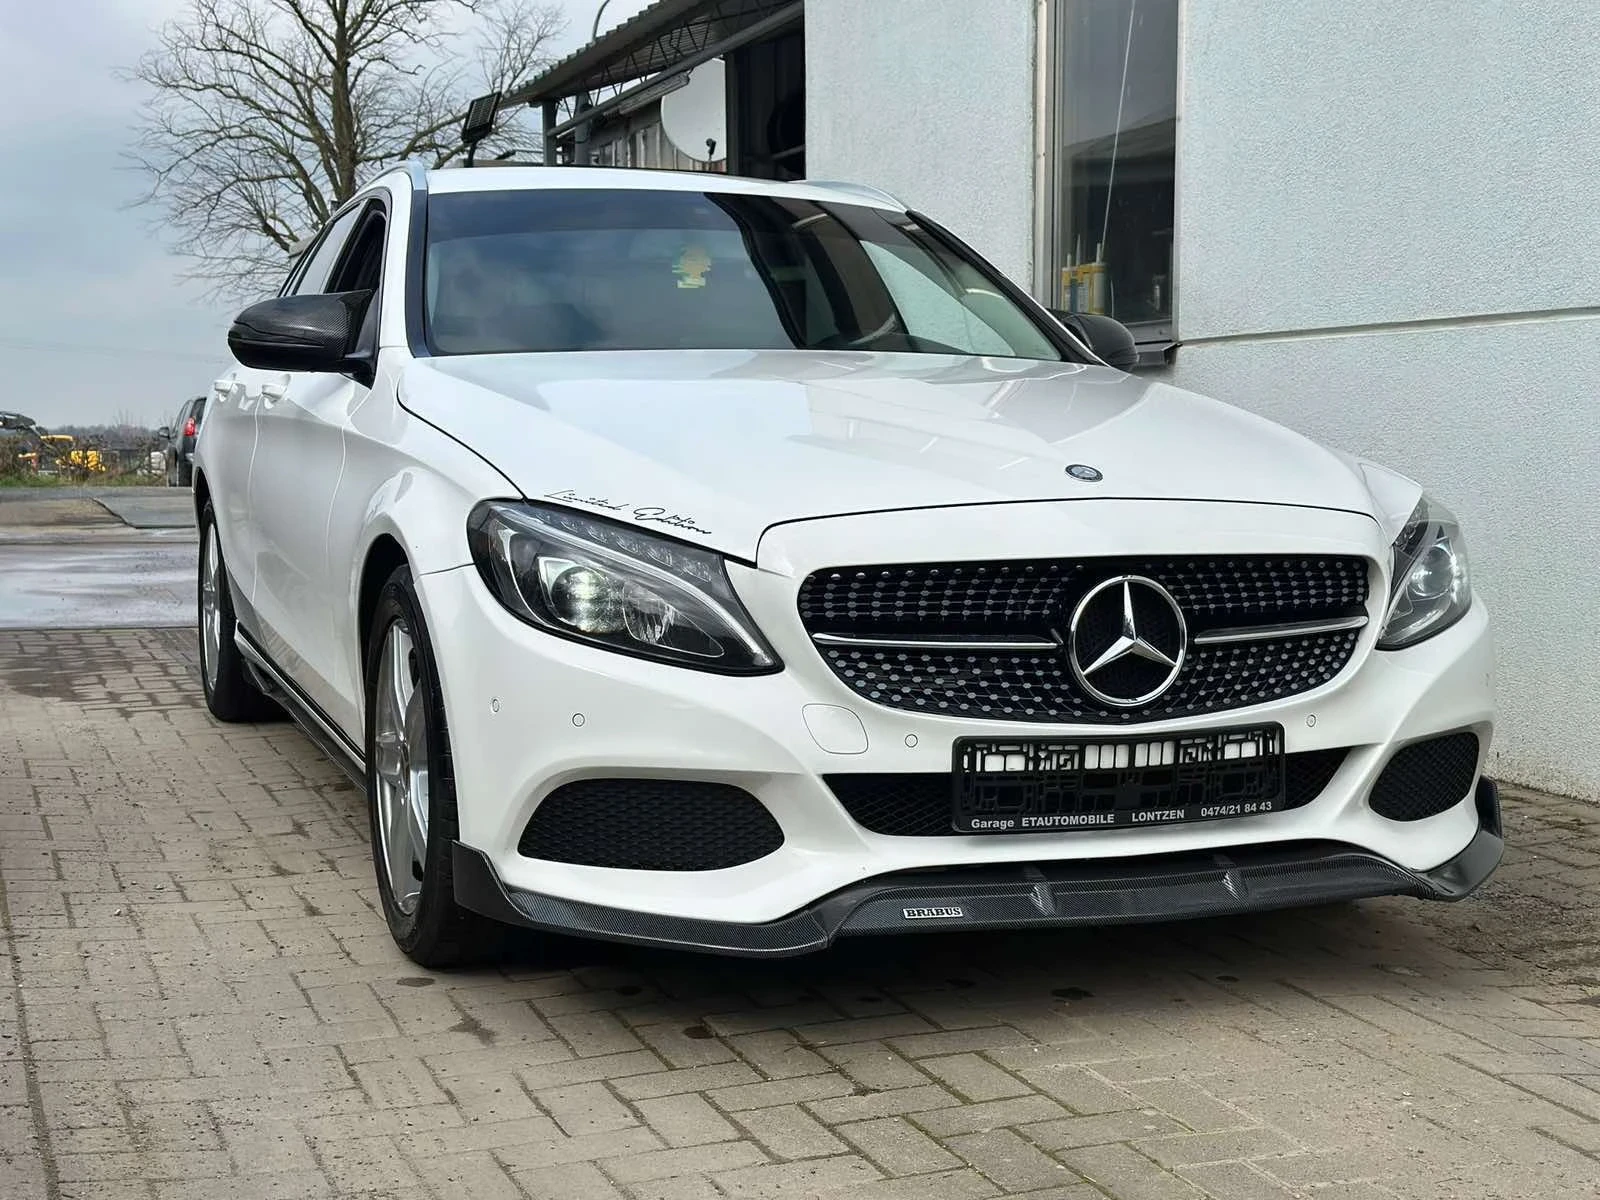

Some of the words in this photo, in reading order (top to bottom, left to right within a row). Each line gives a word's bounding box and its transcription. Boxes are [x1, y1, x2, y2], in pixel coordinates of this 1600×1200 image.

[544, 489, 630, 511] Limited
[633, 507, 712, 535] Edition
[971, 818, 1015, 830] Garage
[1021, 814, 1115, 827] ETAUTOMOBILE
[1131, 809, 1185, 822] LONTZEN
[1200, 805, 1241, 817] 0474/21
[1244, 803, 1257, 813] 84
[1259, 801, 1272, 811] 43
[905, 907, 961, 918] BRABUS
